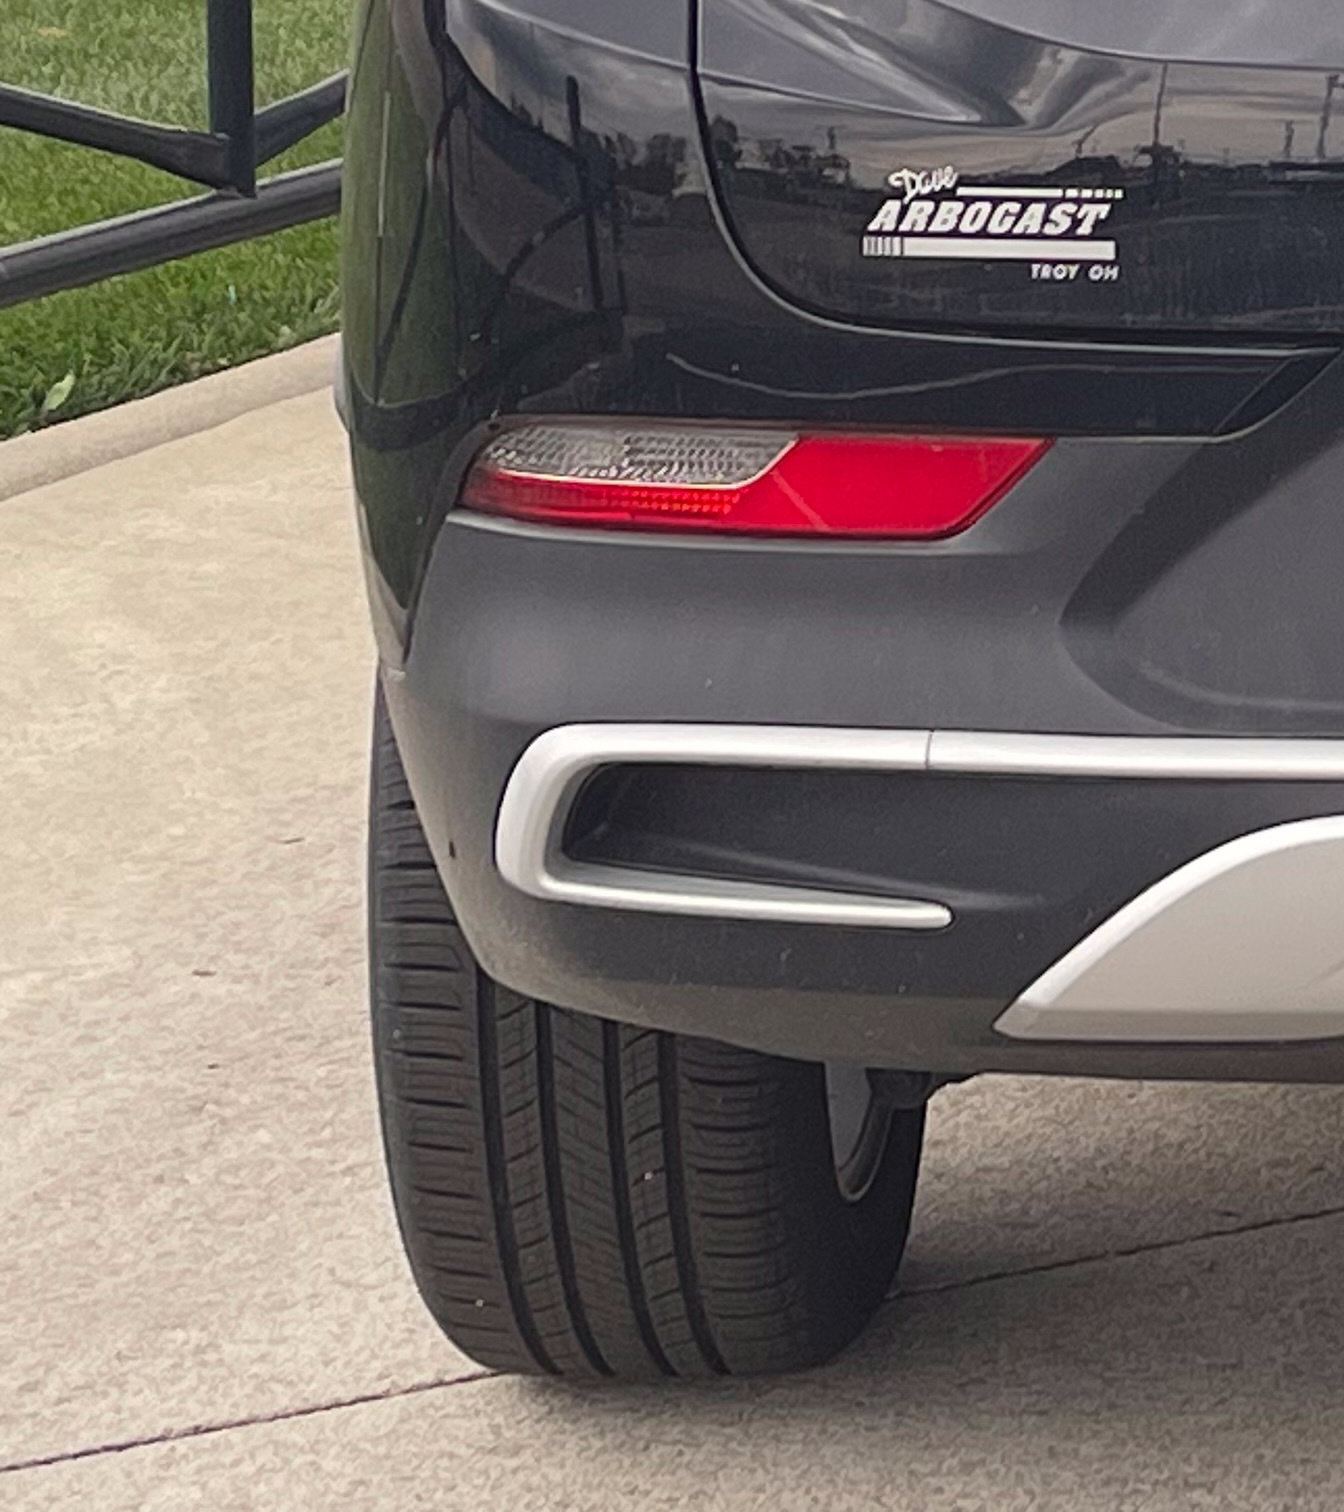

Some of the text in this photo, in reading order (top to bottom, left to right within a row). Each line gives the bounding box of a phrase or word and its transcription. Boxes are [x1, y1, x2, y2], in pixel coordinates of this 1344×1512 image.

[888, 165, 958, 204] Dave
[867, 199, 1111, 236] ARBOGAST
[1030, 263, 1120, 281] TROY OH
